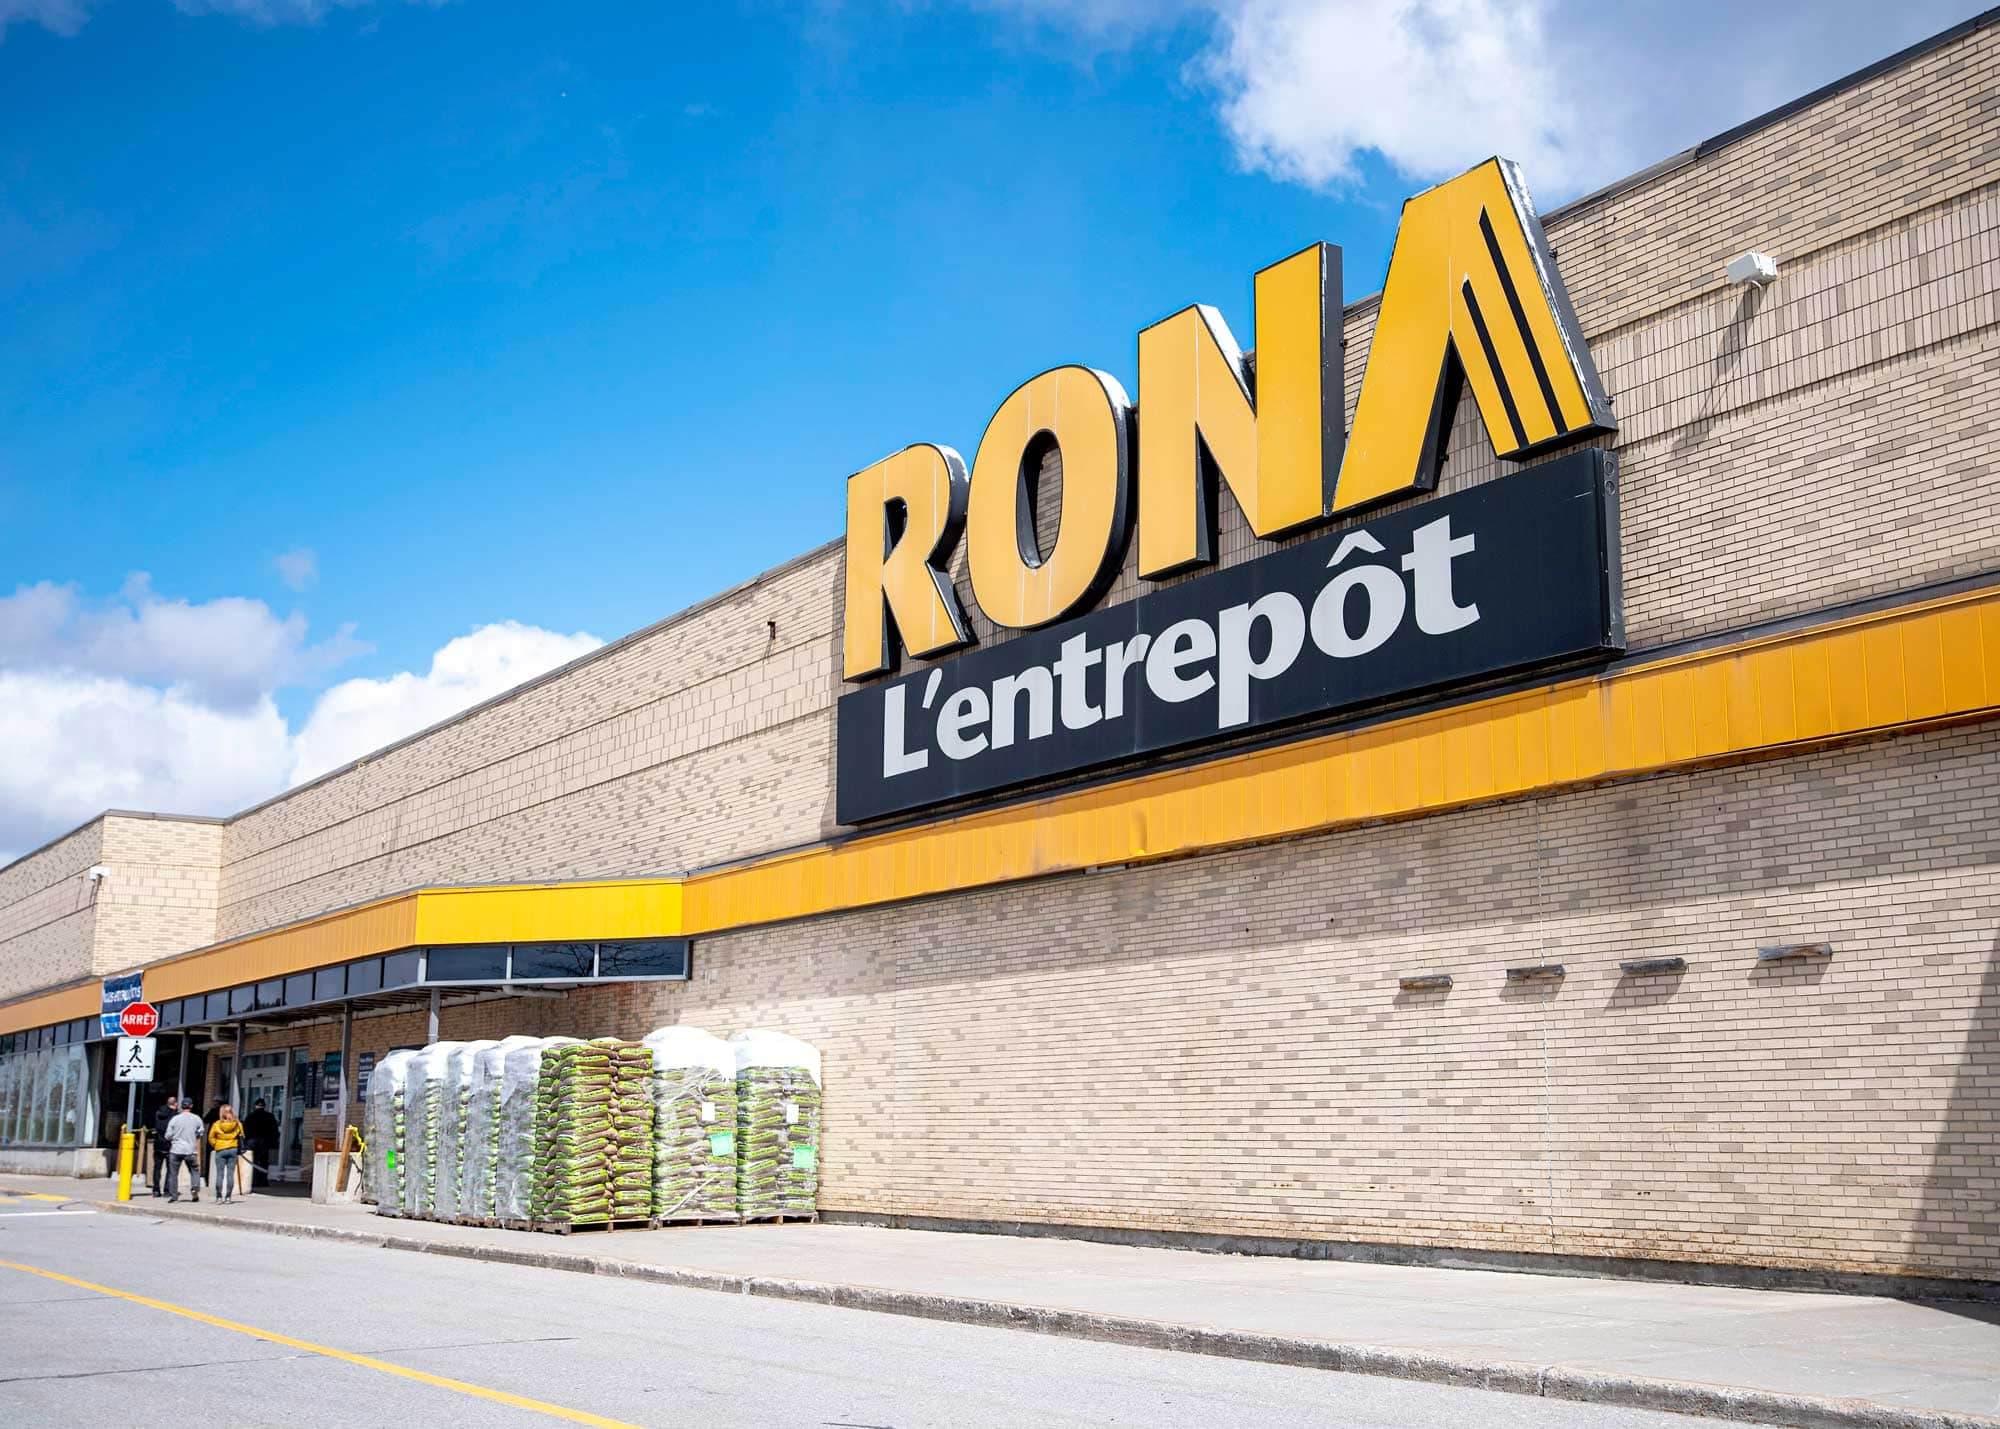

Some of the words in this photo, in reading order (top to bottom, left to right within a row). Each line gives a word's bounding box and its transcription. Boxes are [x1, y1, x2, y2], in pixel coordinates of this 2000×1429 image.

[843, 156, 1612, 682] RONA
[883, 514, 1480, 778] L'entrepôt
[122, 1012, 156, 1026] ARRÊT
